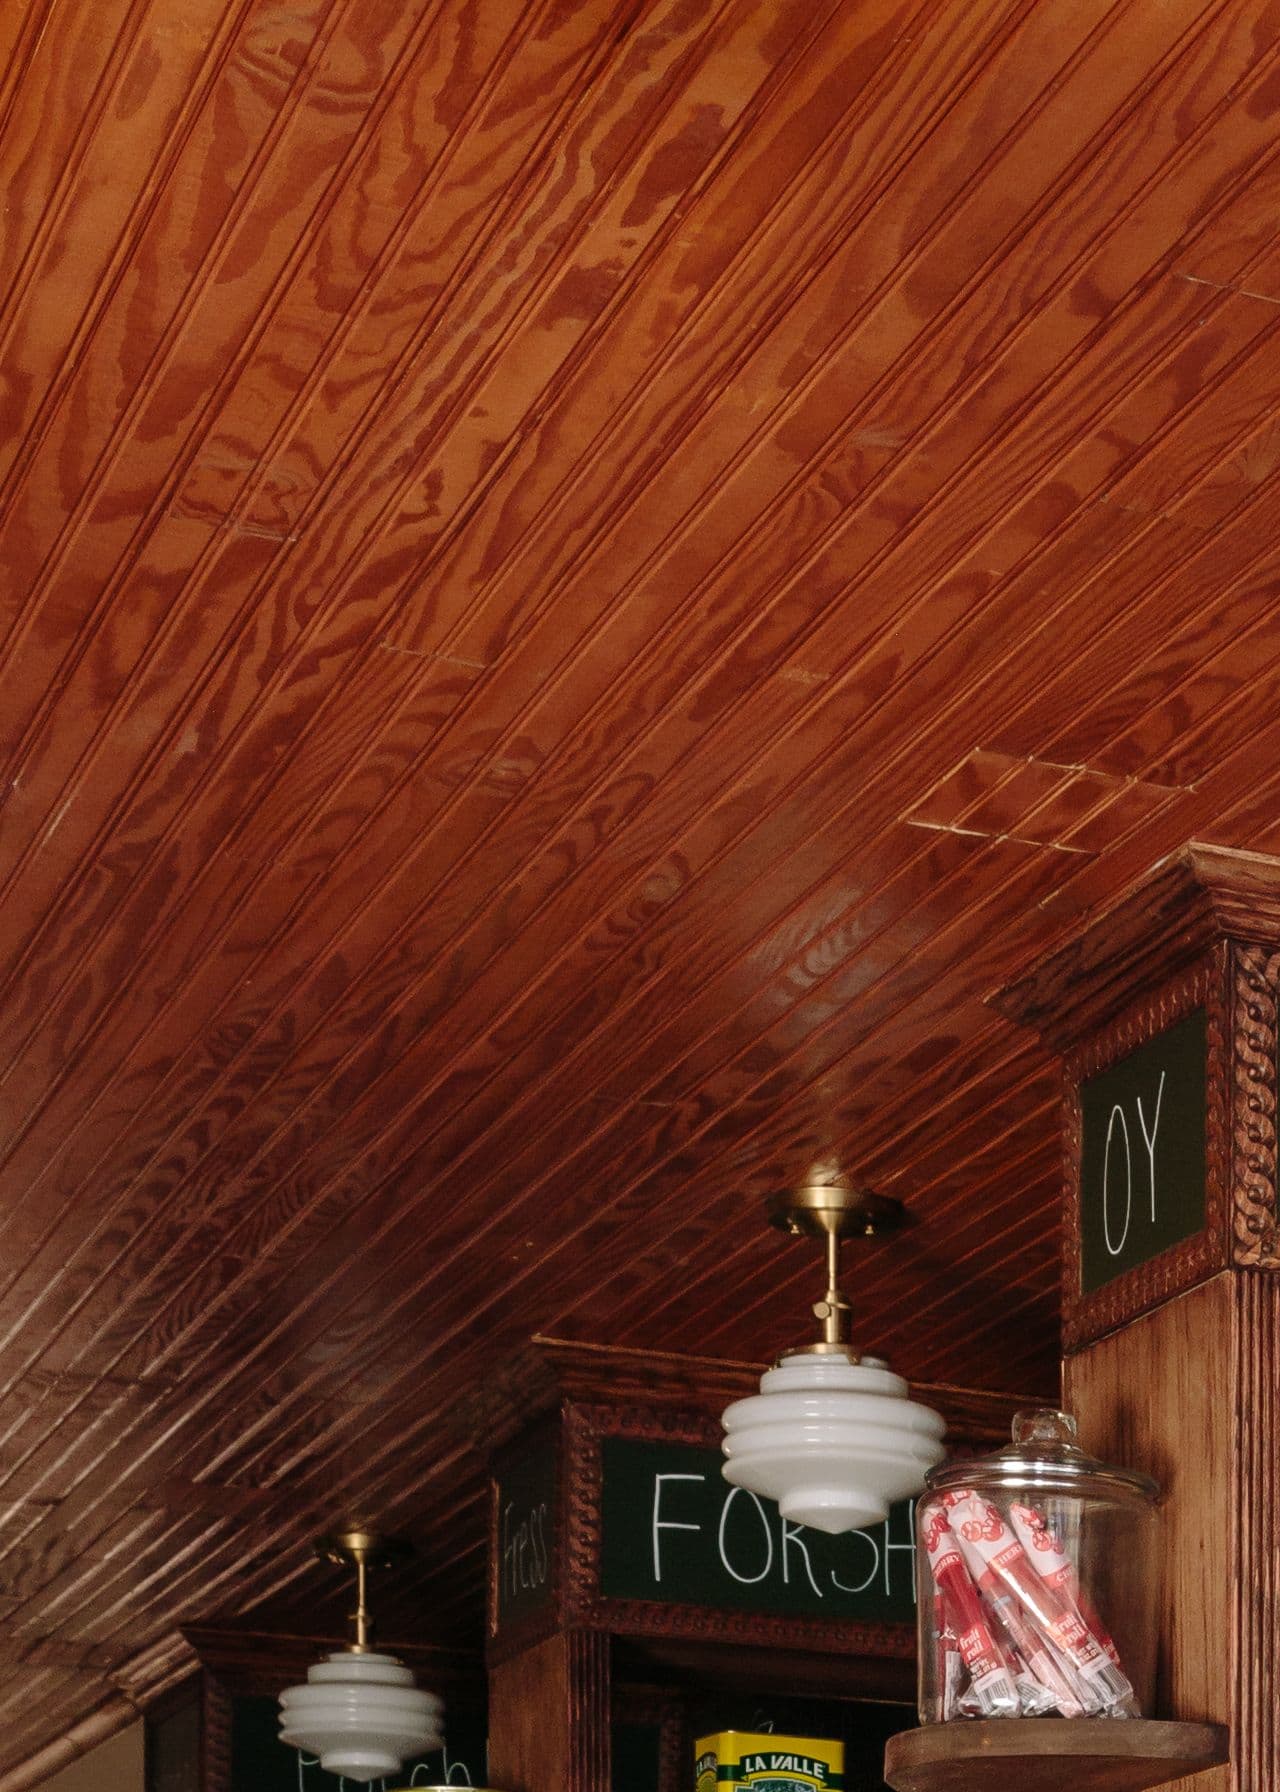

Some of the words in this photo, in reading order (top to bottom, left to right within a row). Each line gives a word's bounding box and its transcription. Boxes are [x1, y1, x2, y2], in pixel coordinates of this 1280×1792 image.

[1104, 1071, 1165, 1255] OY
[744, 1757, 767, 1773] LA
[770, 1754, 825, 1779] VALLE
